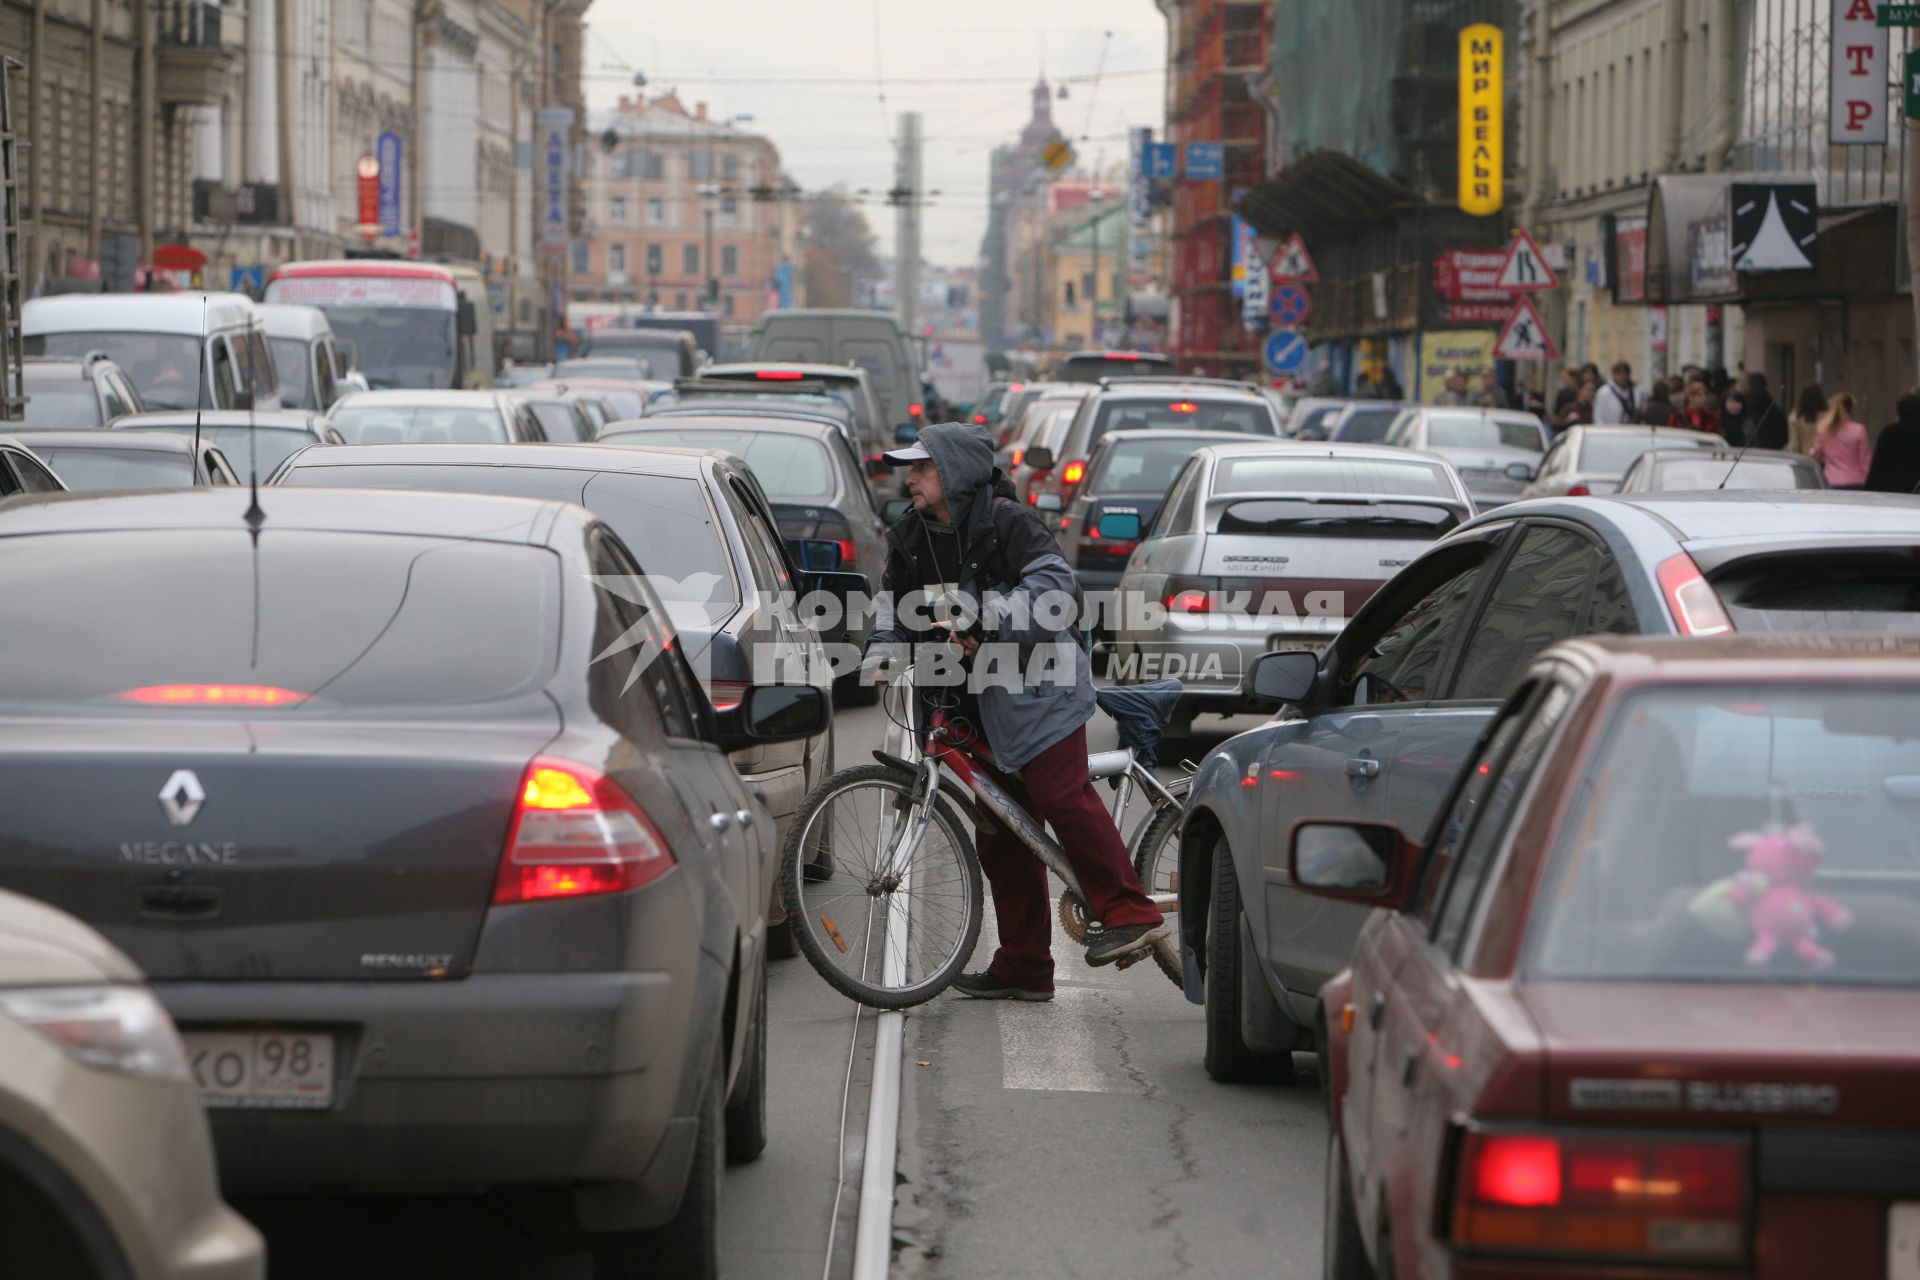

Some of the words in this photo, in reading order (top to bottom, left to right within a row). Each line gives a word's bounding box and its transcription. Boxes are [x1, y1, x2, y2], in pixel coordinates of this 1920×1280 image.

[1471, 39, 1493, 93] МИР
[1472, 106, 1491, 199] БЕЛЬЯ
[120, 841, 239, 865] MEGANE
[361, 953, 454, 968] RENAULT
[263, 1039, 311, 1075] 98
